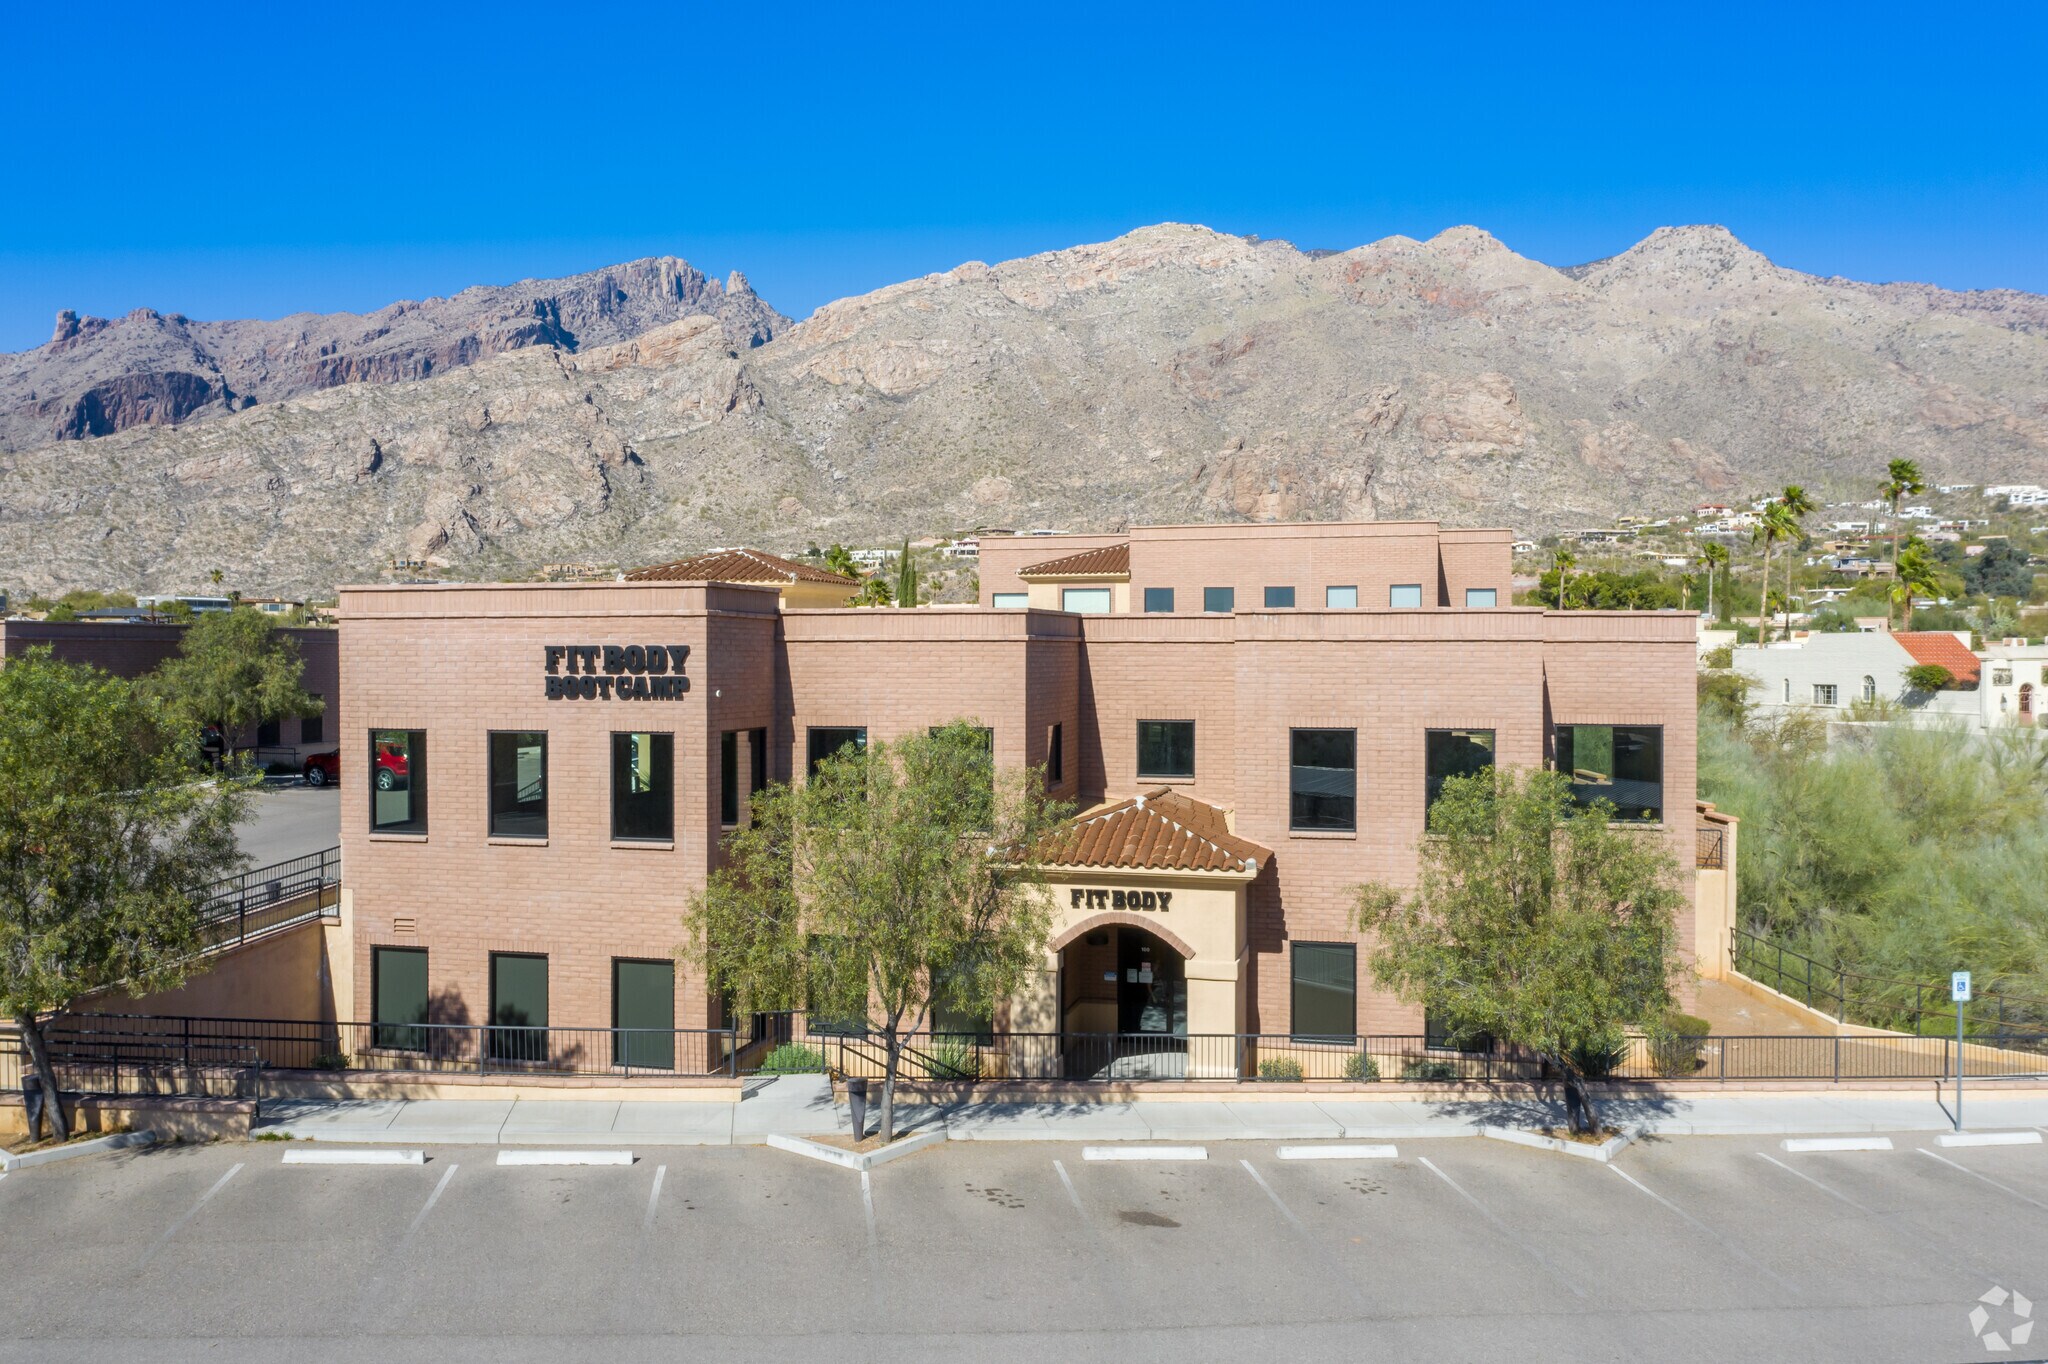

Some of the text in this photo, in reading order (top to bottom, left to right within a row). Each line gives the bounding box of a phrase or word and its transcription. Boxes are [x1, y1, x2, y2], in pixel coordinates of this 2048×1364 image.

[545, 645, 691, 675] FIT BODY
[545, 676, 691, 701] BOOT CAMP
[1070, 888, 1173, 912] FIT BODY
